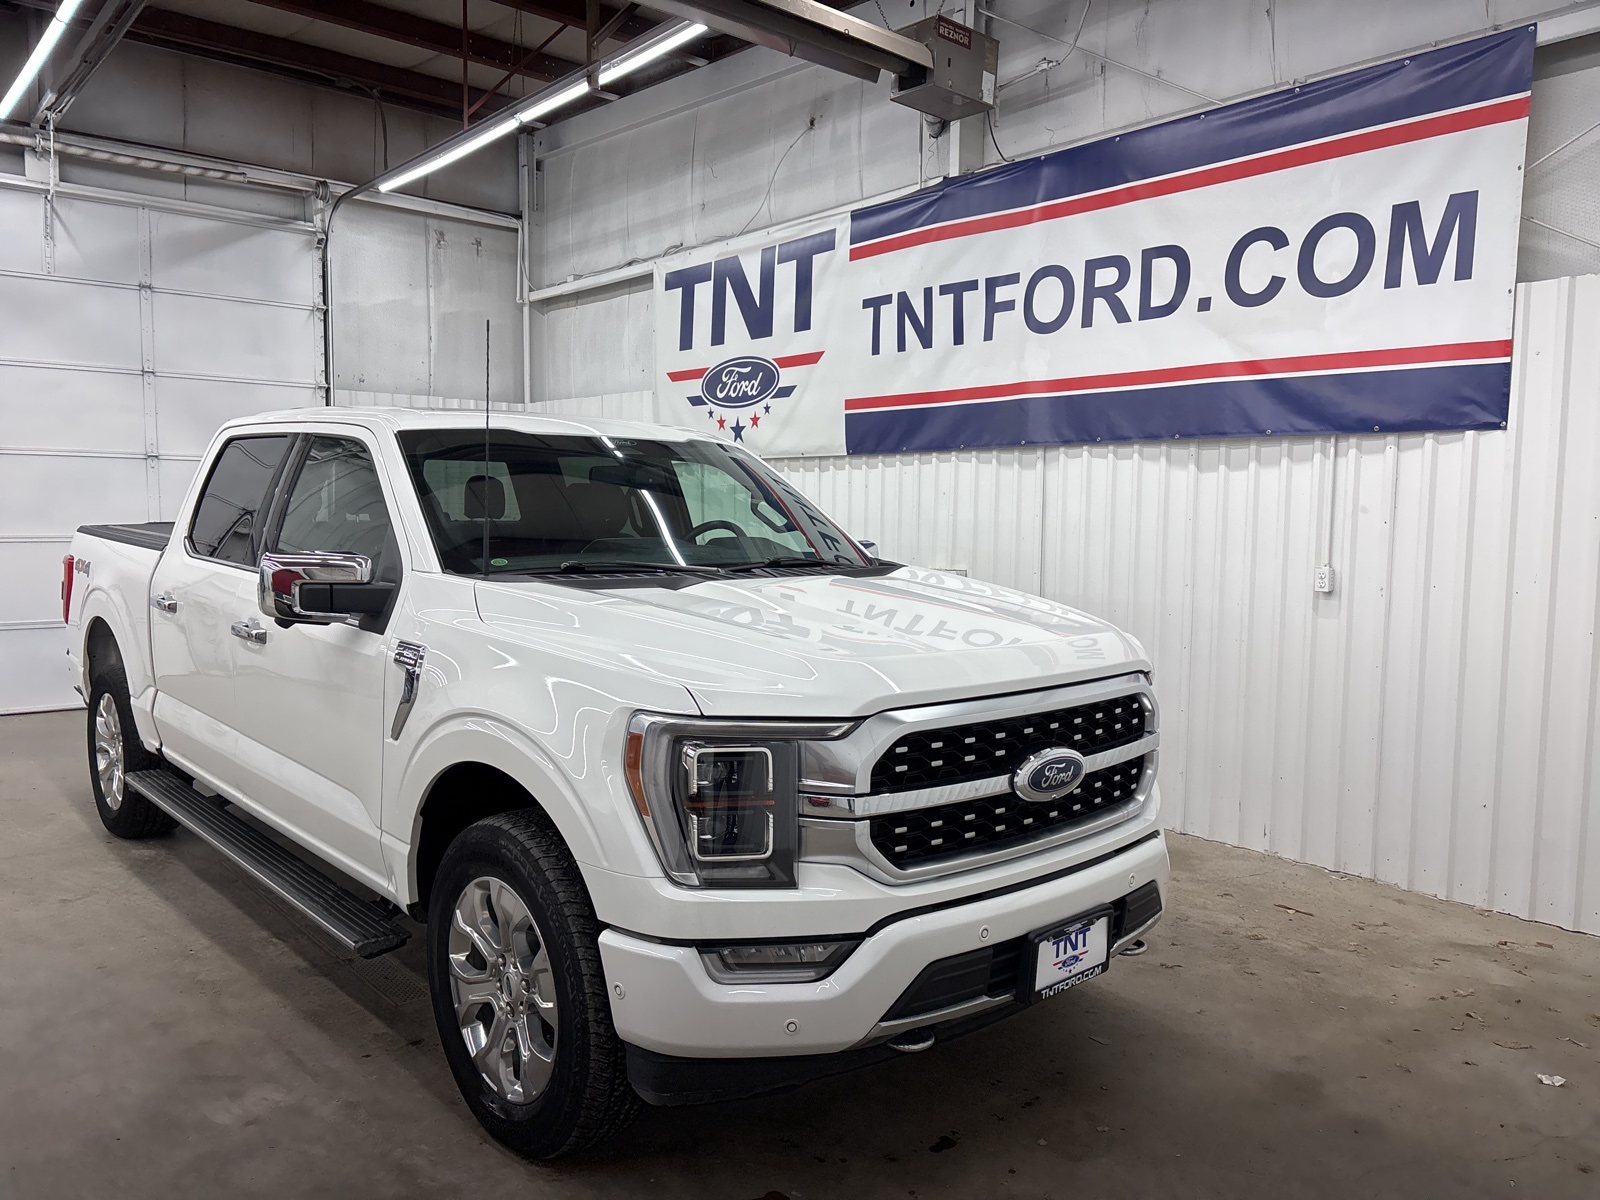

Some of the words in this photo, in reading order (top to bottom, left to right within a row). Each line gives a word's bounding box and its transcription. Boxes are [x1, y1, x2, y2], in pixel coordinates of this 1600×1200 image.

[940, 25, 969, 45] REZNOR
[664, 228, 836, 351] TNT
[862, 190, 1479, 357] TNTFORD.COM
[716, 366, 762, 399] Ford
[1041, 762, 1074, 788] Ford
[1052, 926, 1091, 959] TNT
[1041, 965, 1102, 1000] TNTFORD.COM
